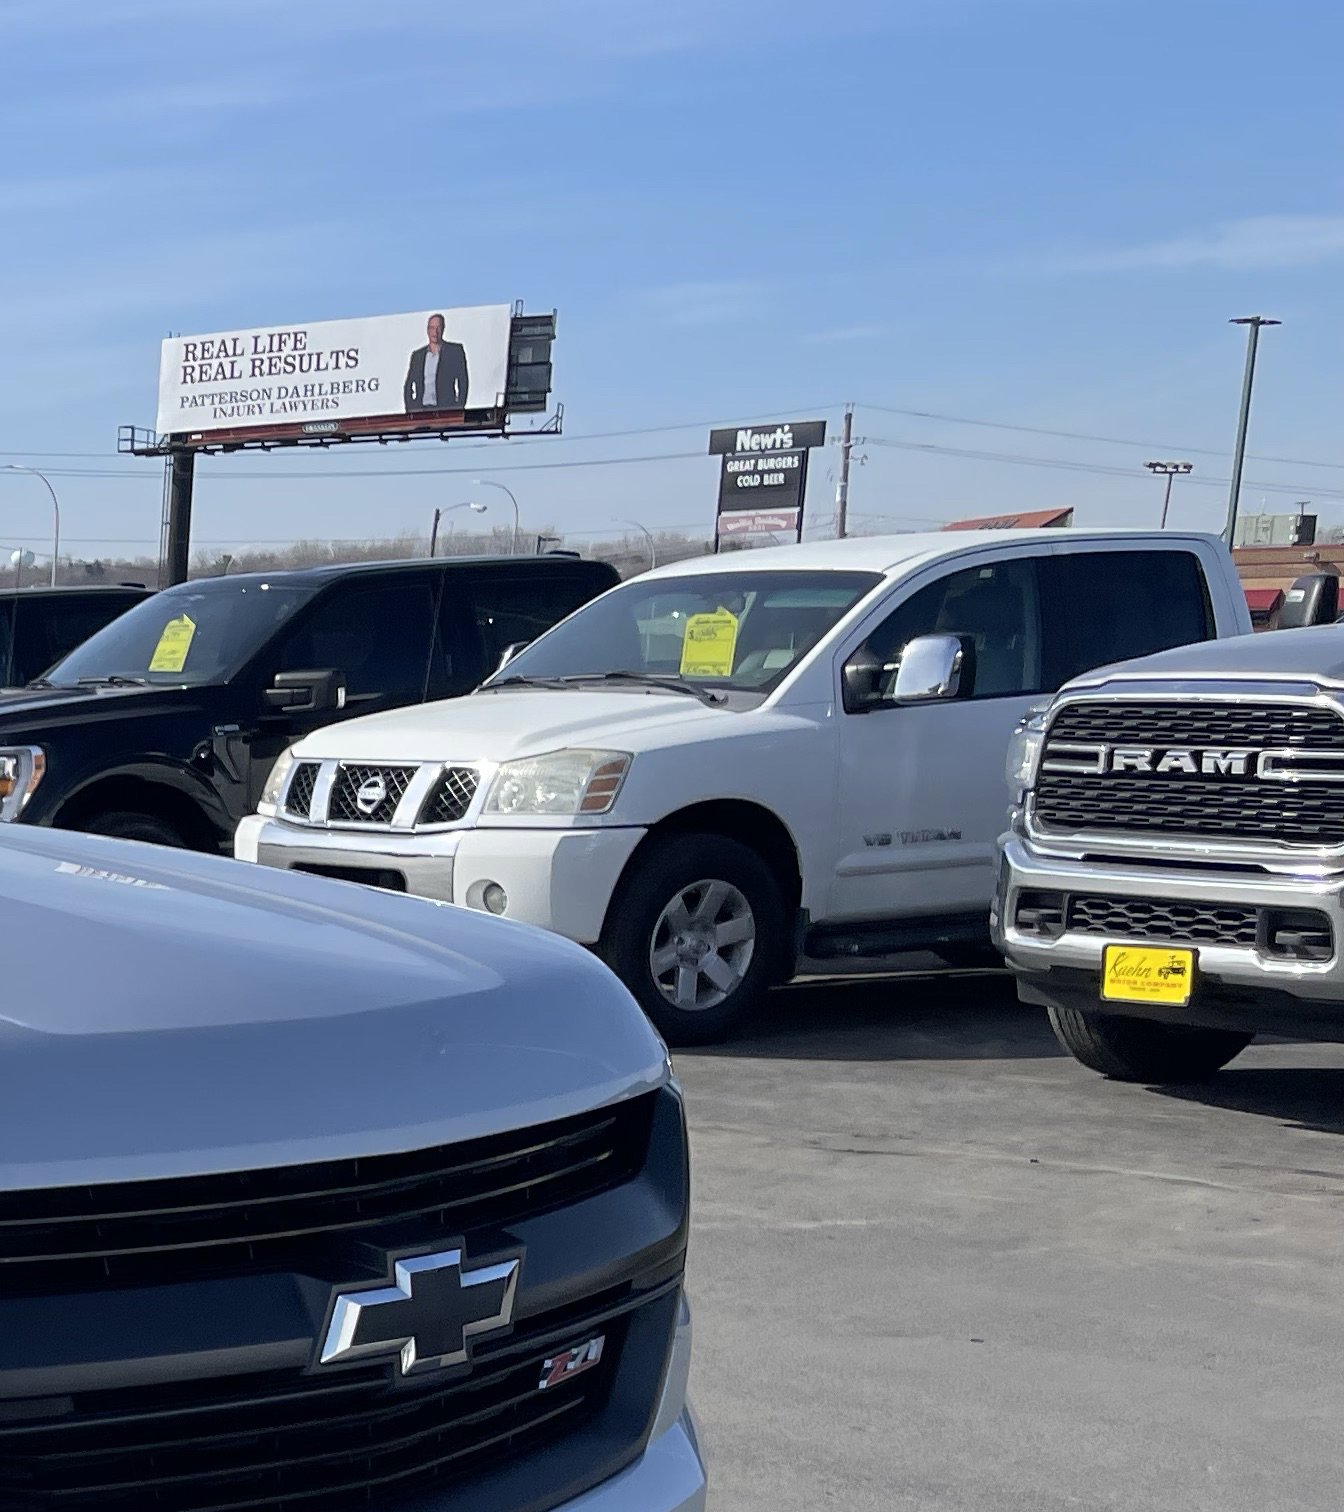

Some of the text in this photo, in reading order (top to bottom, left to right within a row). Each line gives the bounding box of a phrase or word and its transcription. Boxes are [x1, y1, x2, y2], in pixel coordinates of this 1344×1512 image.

[183, 331, 307, 362] REAL LIFE
[181, 348, 359, 385] REAL RESULTS
[180, 378, 380, 409] PATTERSON DAHLBERG
[212, 398, 339, 419] INJURY LAWYERS
[736, 425, 793, 451] Newt's
[727, 456, 799, 472] GREAT BURGERS
[737, 473, 785, 487] COLD BEER
[1112, 749, 1249, 774] RAM
[1109, 952, 1153, 978] Kuehn
